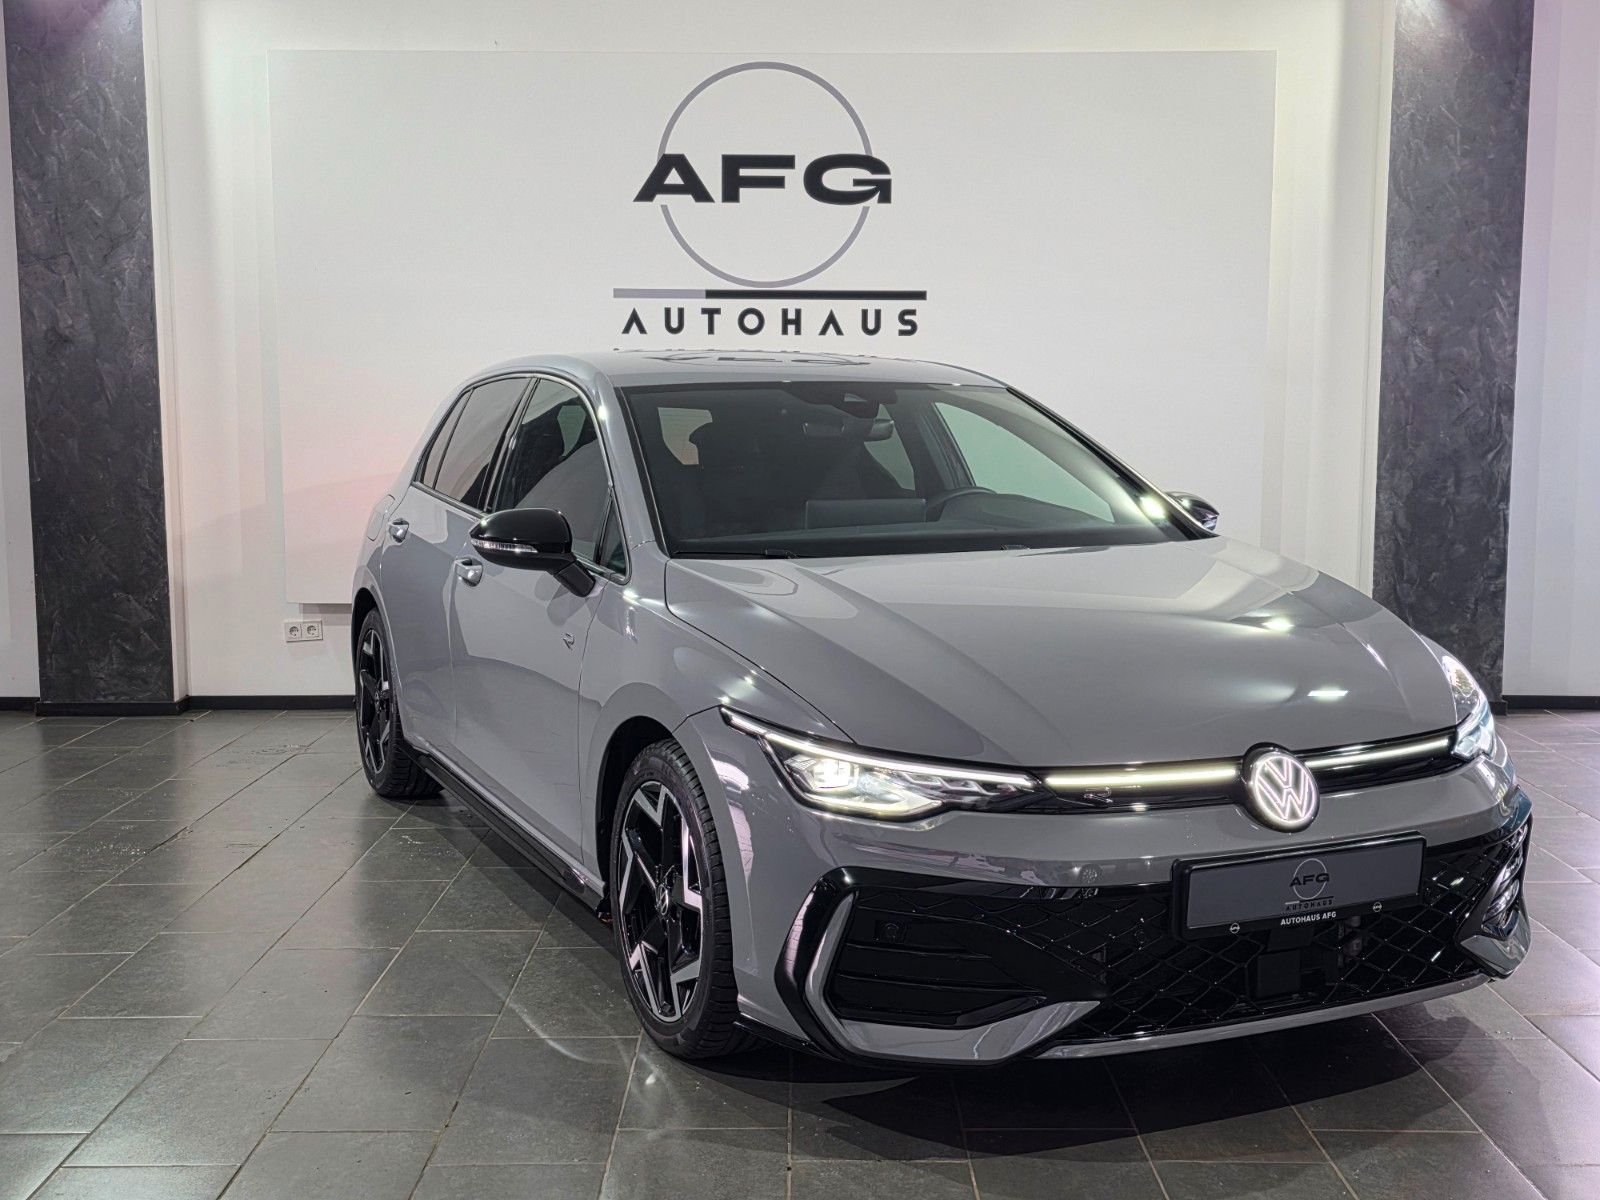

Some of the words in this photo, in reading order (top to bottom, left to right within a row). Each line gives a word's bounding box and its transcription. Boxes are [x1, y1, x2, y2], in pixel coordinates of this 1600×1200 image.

[633, 153, 892, 205] AFG
[621, 307, 918, 336] AUTOHAUS
[1289, 872, 1330, 888] AFG
[1285, 899, 1333, 912] AUTOHAUS
[1280, 913, 1321, 926] AUTOHAUS
[1322, 911, 1337, 920] AFG
